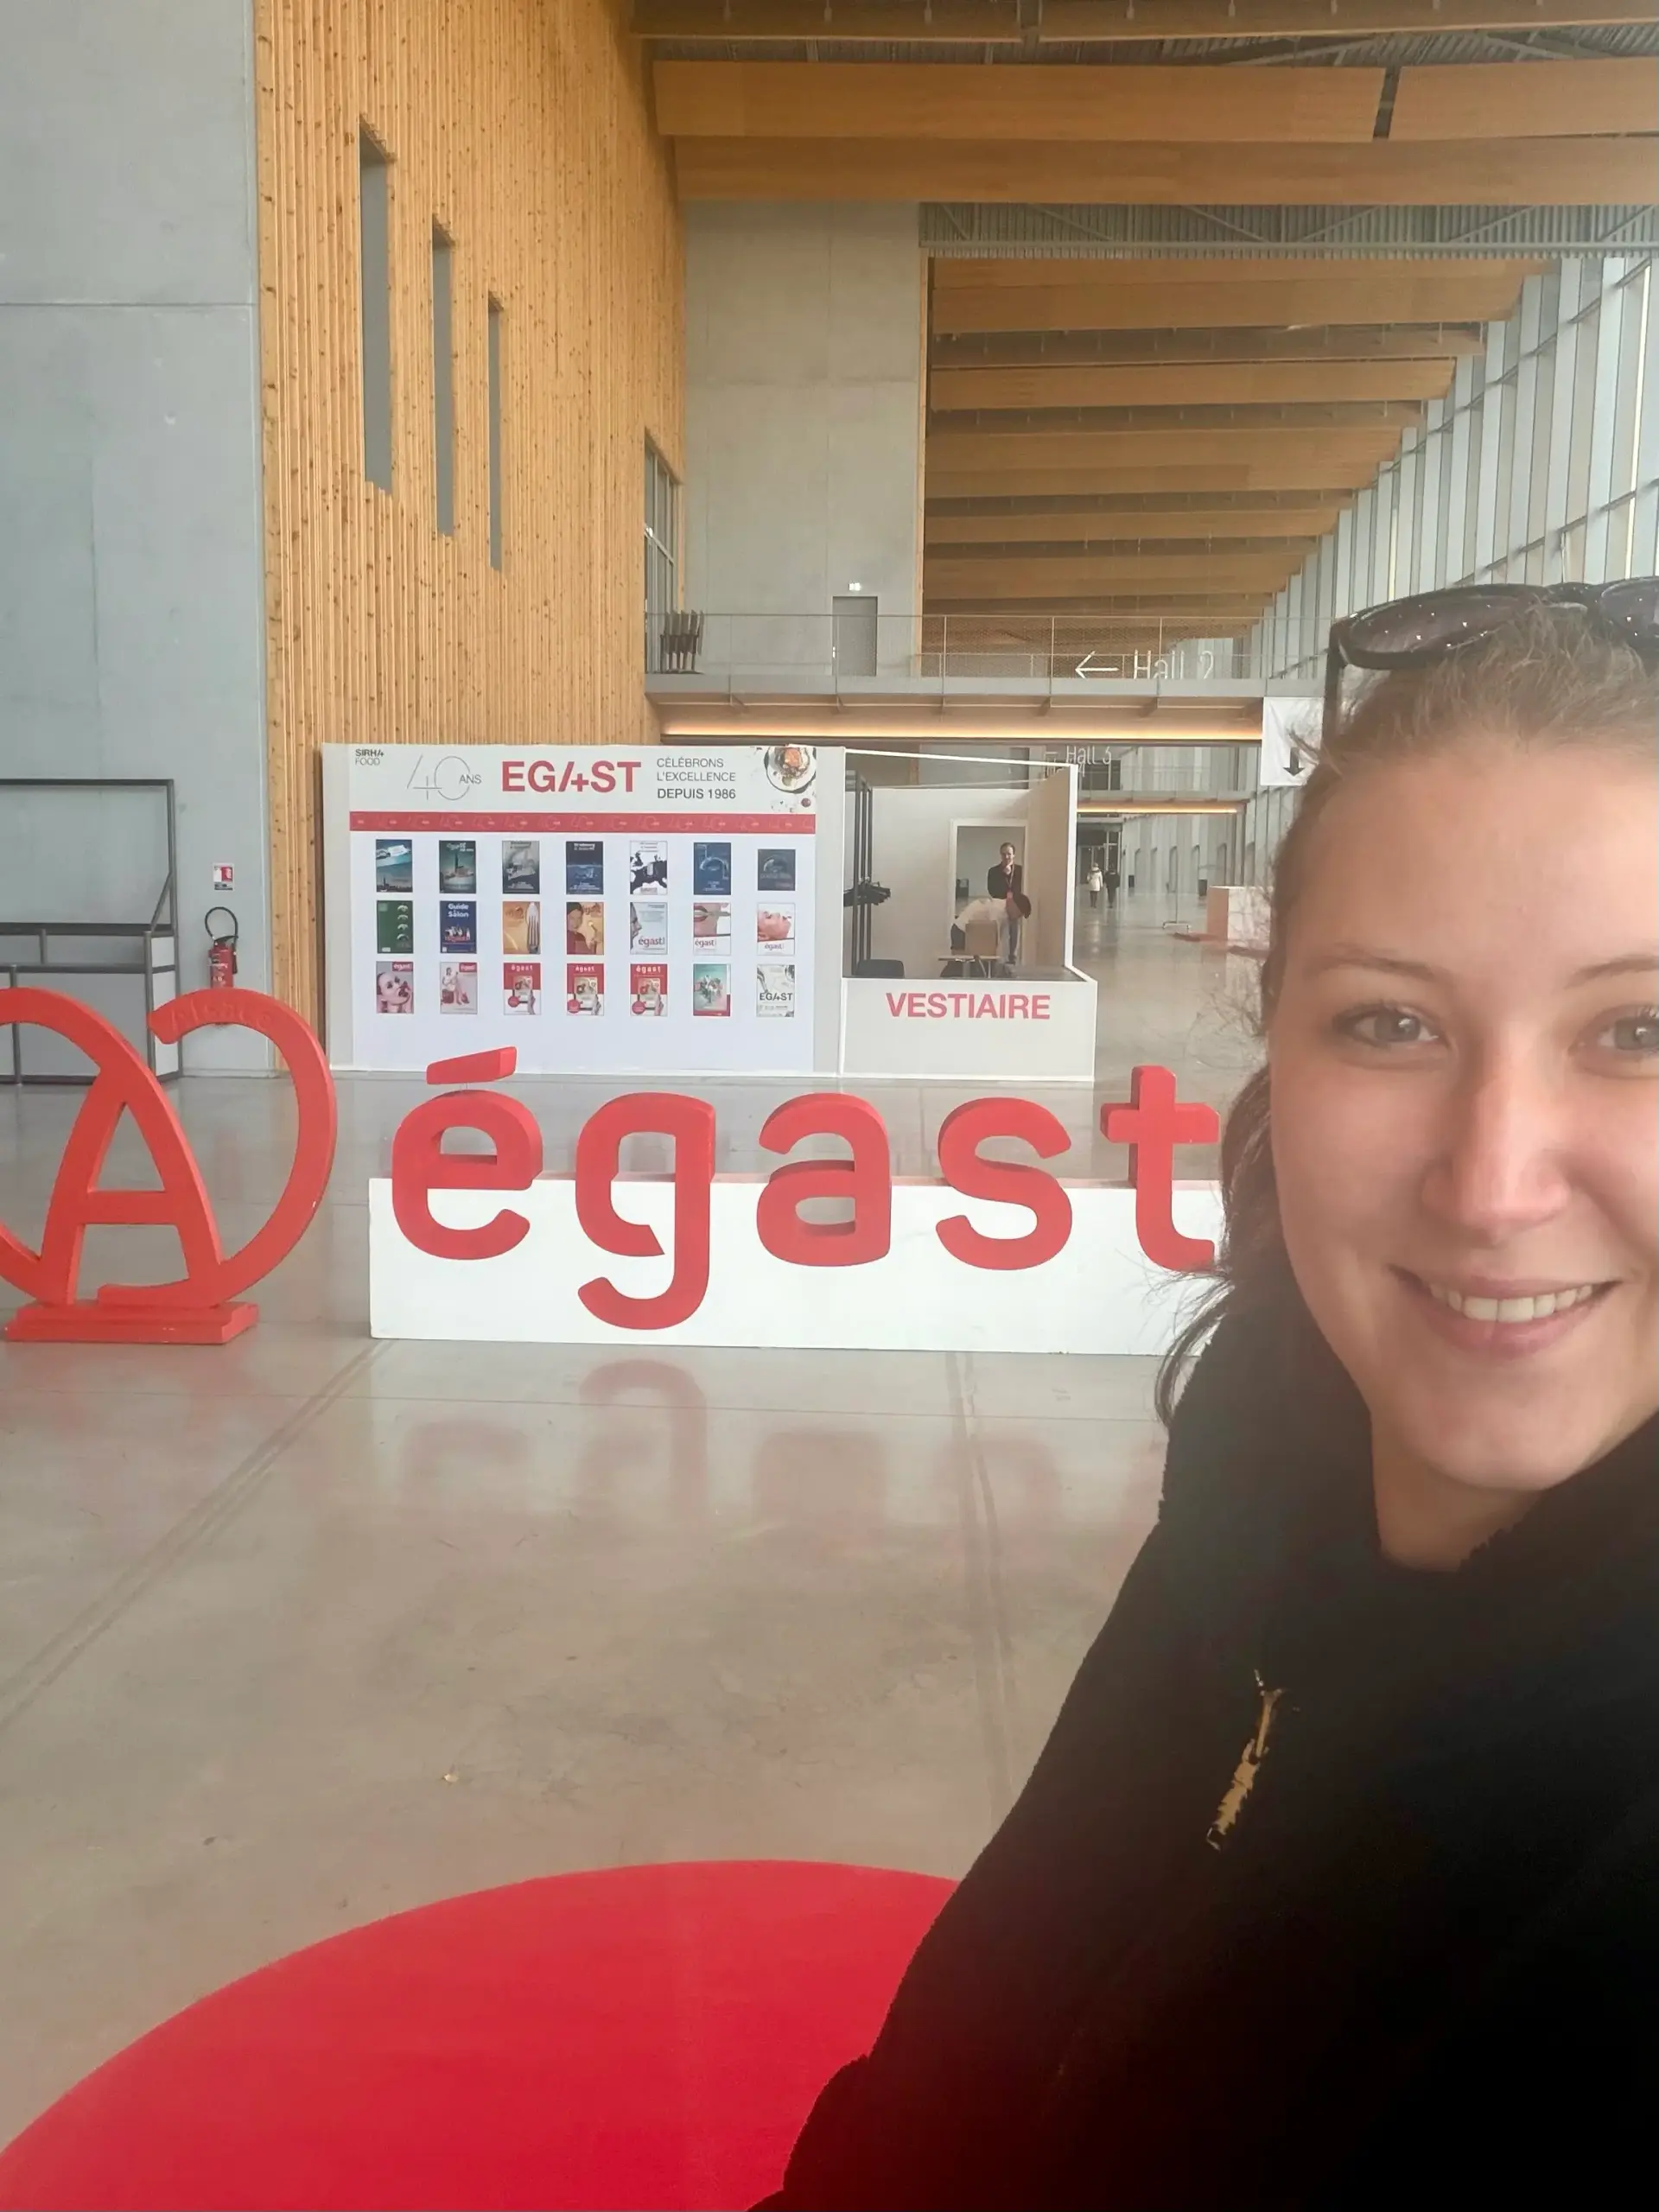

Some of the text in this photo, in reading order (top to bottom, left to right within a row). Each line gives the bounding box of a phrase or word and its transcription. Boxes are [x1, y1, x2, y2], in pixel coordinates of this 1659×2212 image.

[1133, 649, 1185, 679] Hall
[1065, 745, 1102, 765] Hall
[355, 757, 380, 766] FOOD
[657, 756, 724, 768] CÉLÉBRONS
[459, 774, 482, 785] ANS
[657, 772, 736, 782] L'EXCELLENCE
[658, 789, 736, 799] DEPUIS 1986
[886, 992, 1051, 1020] VESTIAIRE
[391, 1046, 1220, 1331] égast
